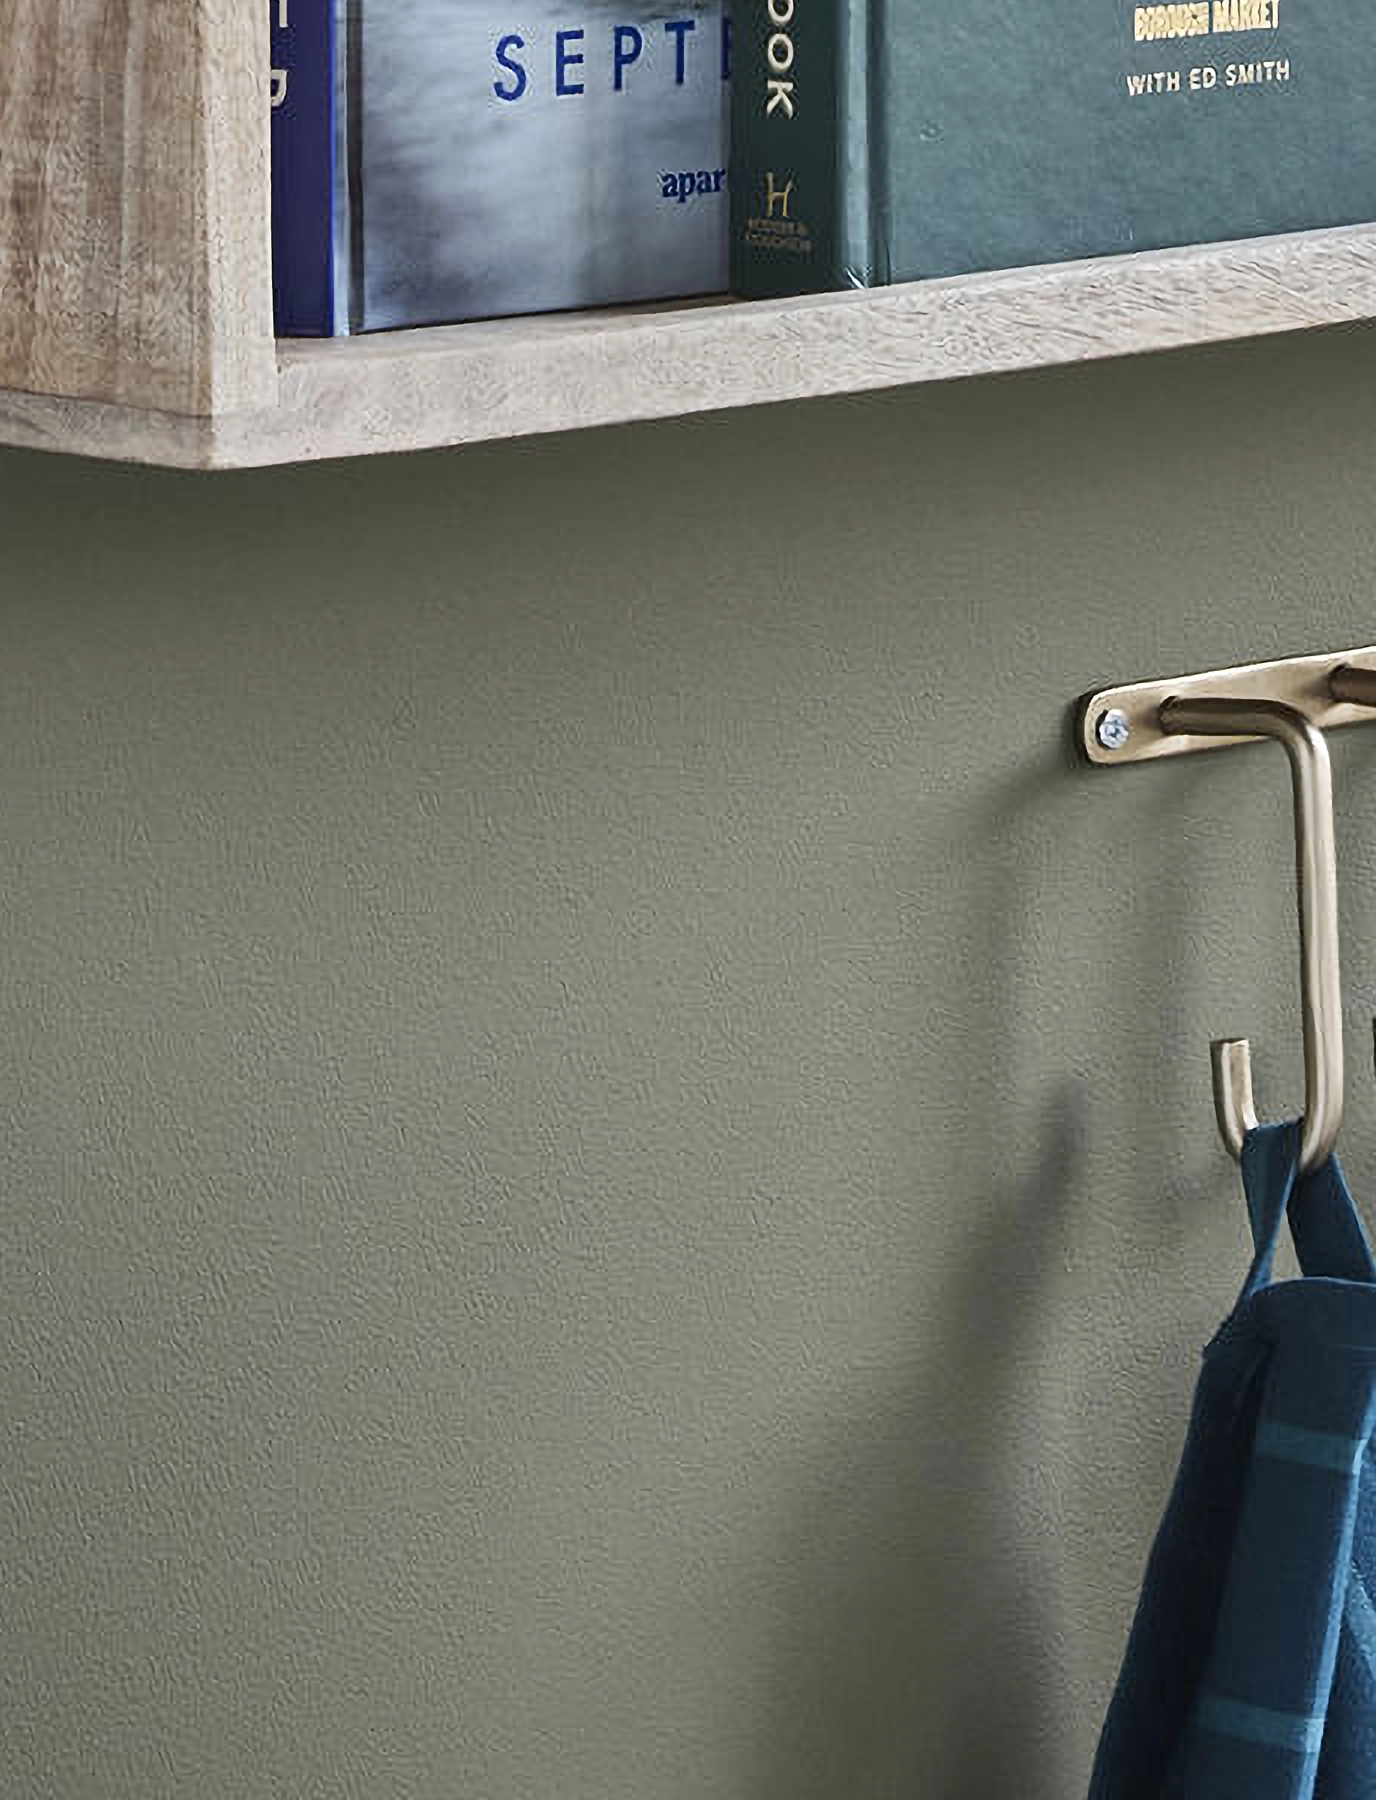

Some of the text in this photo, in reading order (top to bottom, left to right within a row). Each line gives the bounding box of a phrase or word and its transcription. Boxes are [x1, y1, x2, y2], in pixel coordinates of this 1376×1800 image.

[493, 16, 729, 101] SEPT
[1126, 58, 1290, 96] WITH ED SMITH
